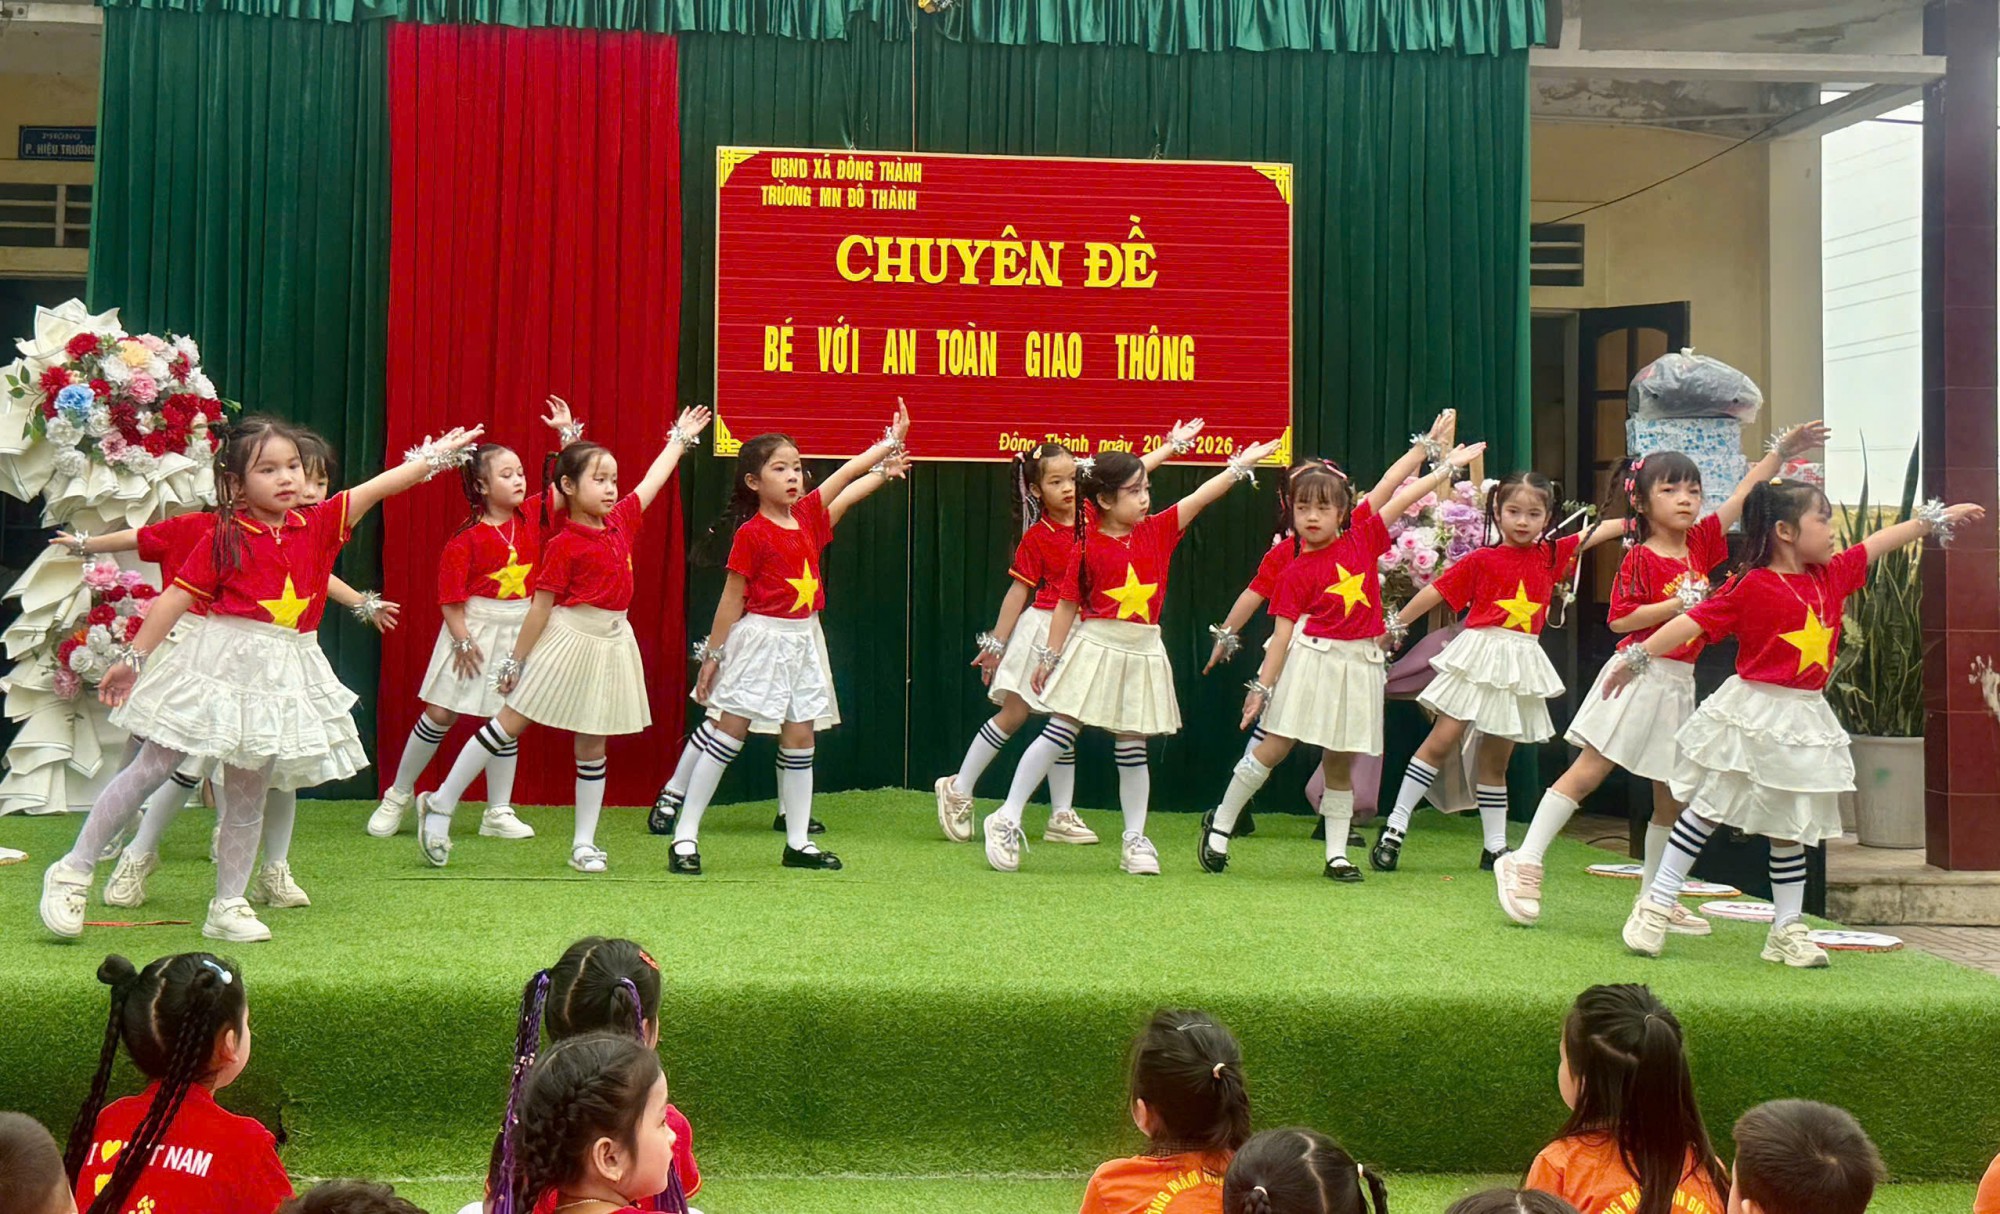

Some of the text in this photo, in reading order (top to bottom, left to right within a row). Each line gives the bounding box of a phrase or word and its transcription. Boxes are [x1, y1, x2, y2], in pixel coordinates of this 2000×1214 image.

[771, 153, 922, 183] UBND XÃ ĐÔNG THÀNH
[761, 179, 917, 210] TRƯỜNG MN ĐÔ THÀNH
[836, 214, 1158, 288] CHUYÊN ĐỀ
[764, 315, 1195, 381] BÉ VỚI AN TOÀN GIAO THÔNG
[1196, 435, 1233, 455] 2026
[87, 1142, 98, 1166] I
[163, 1146, 213, 1178] NAM
